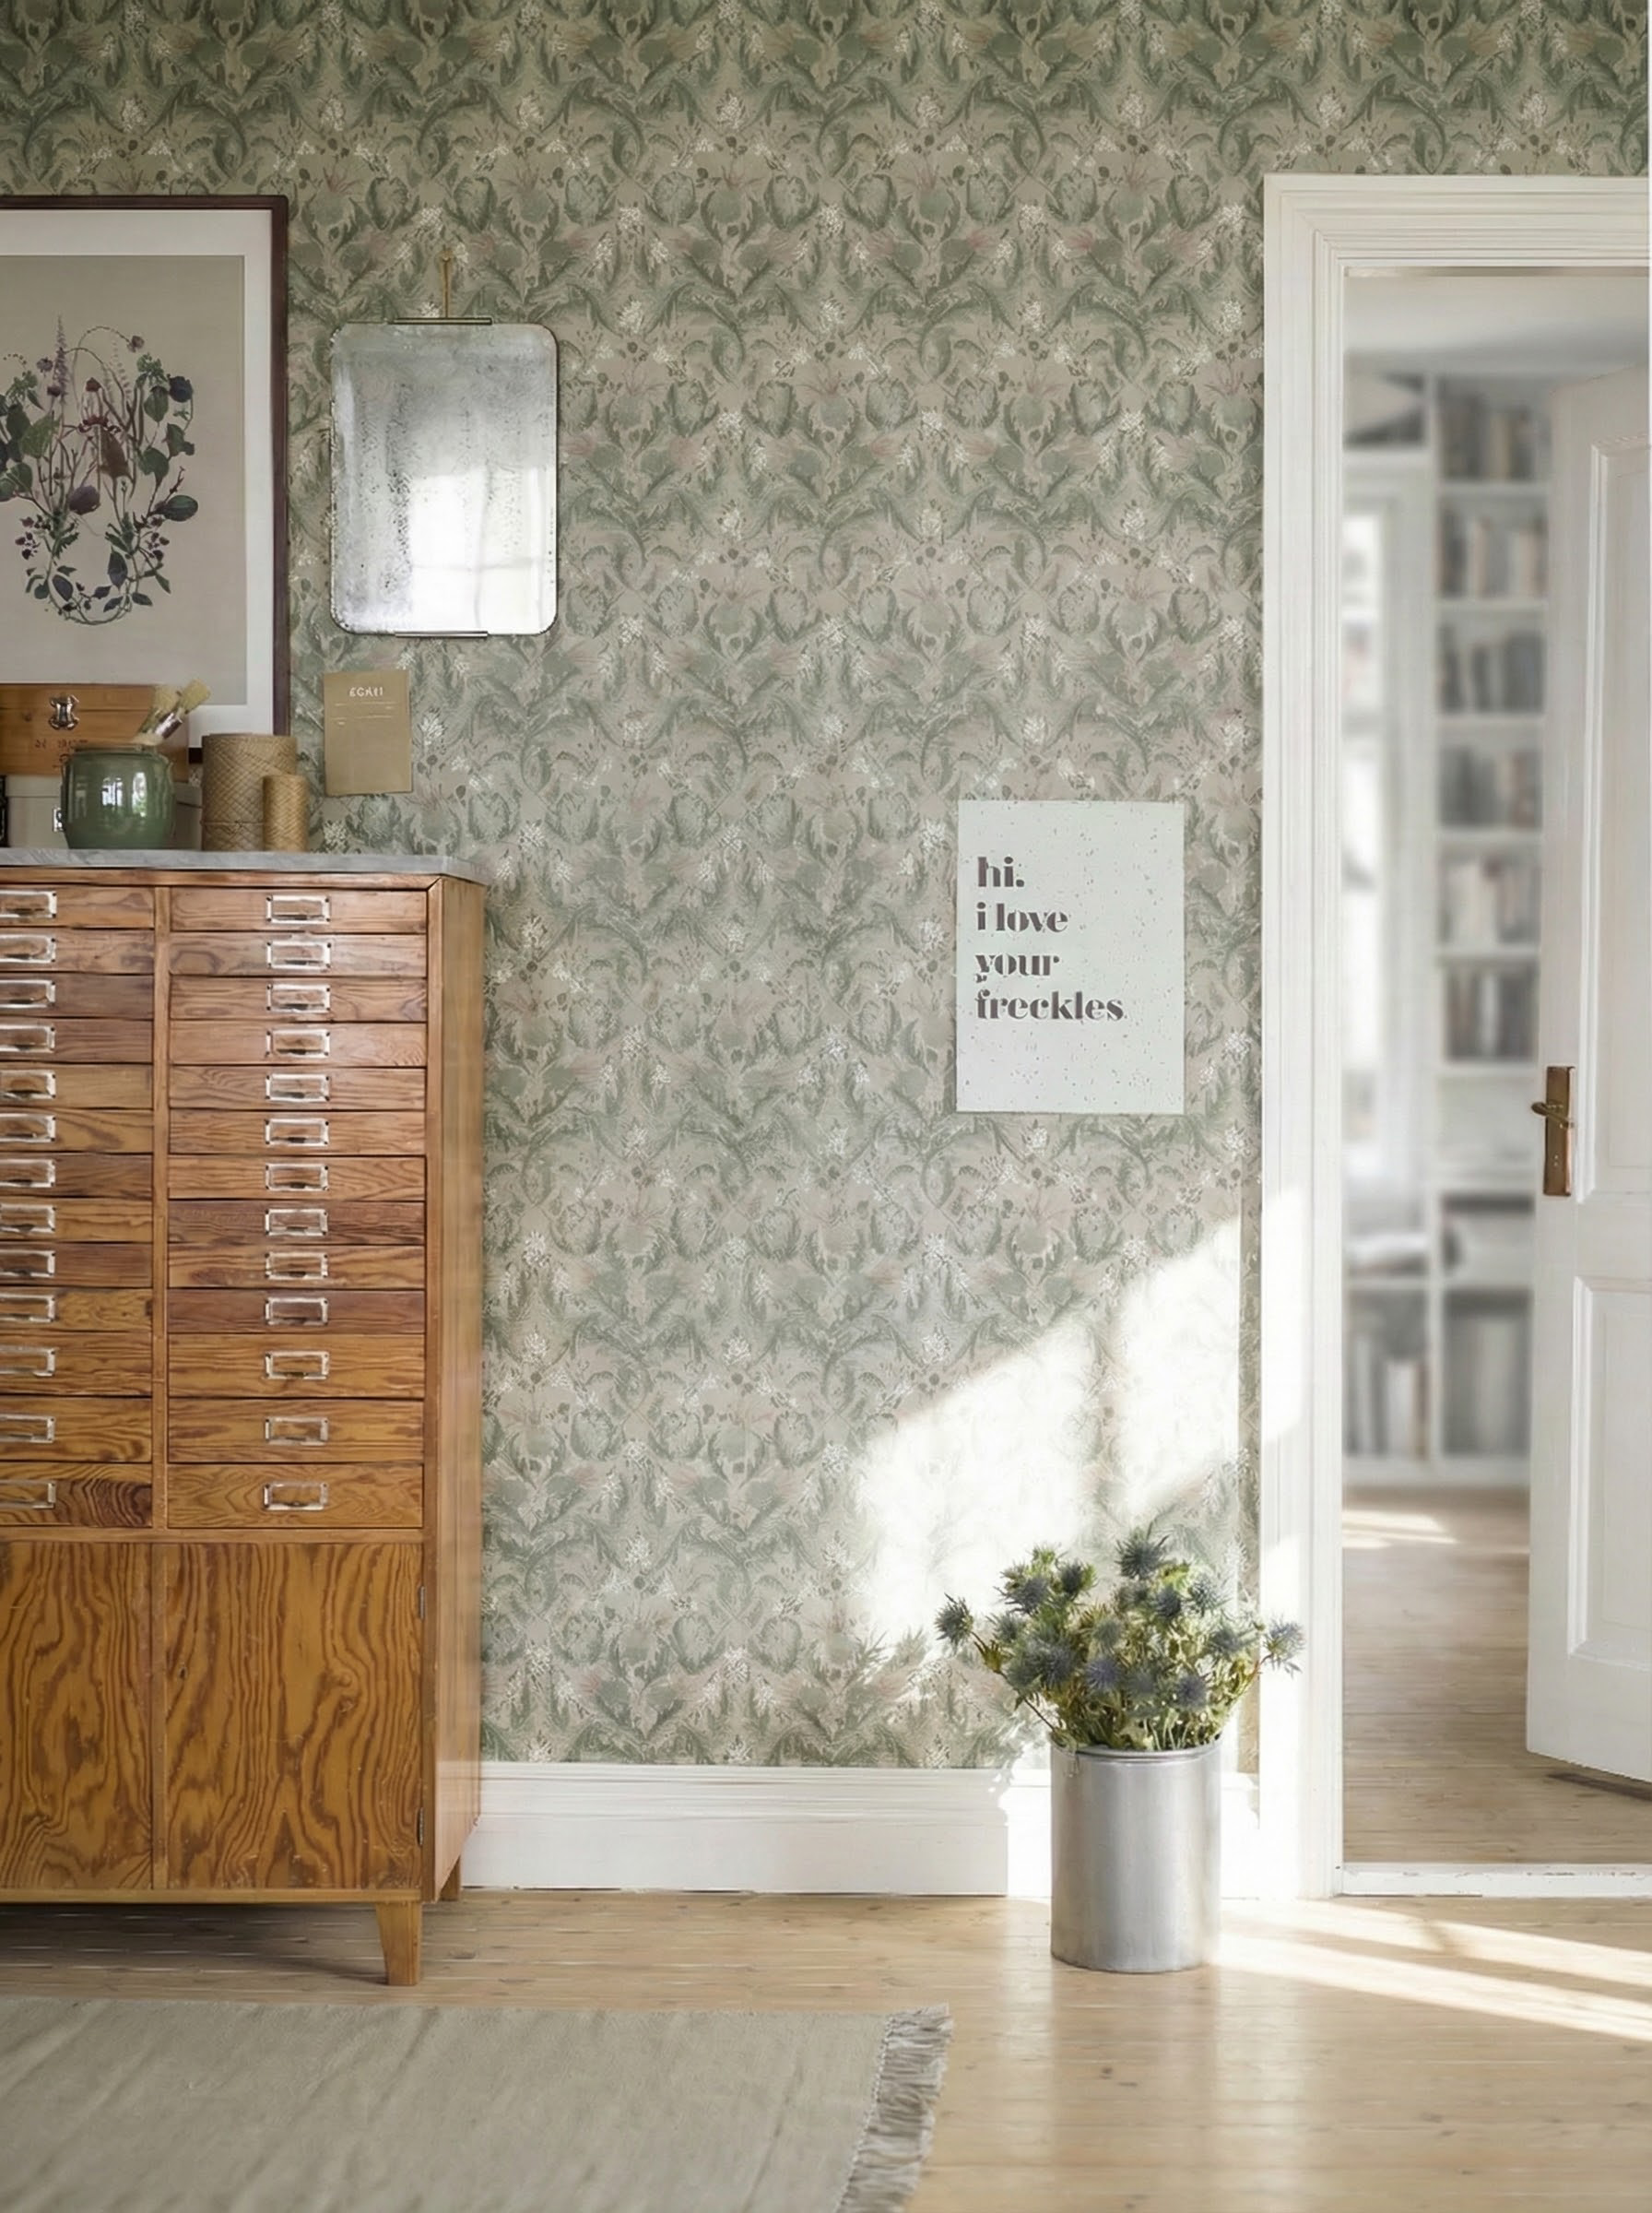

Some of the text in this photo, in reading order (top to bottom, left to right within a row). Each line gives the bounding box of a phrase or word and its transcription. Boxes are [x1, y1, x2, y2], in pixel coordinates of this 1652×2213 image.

[977, 856, 1025, 888] hi.
[976, 901, 1068, 933] i love
[974, 954, 1060, 984] your
